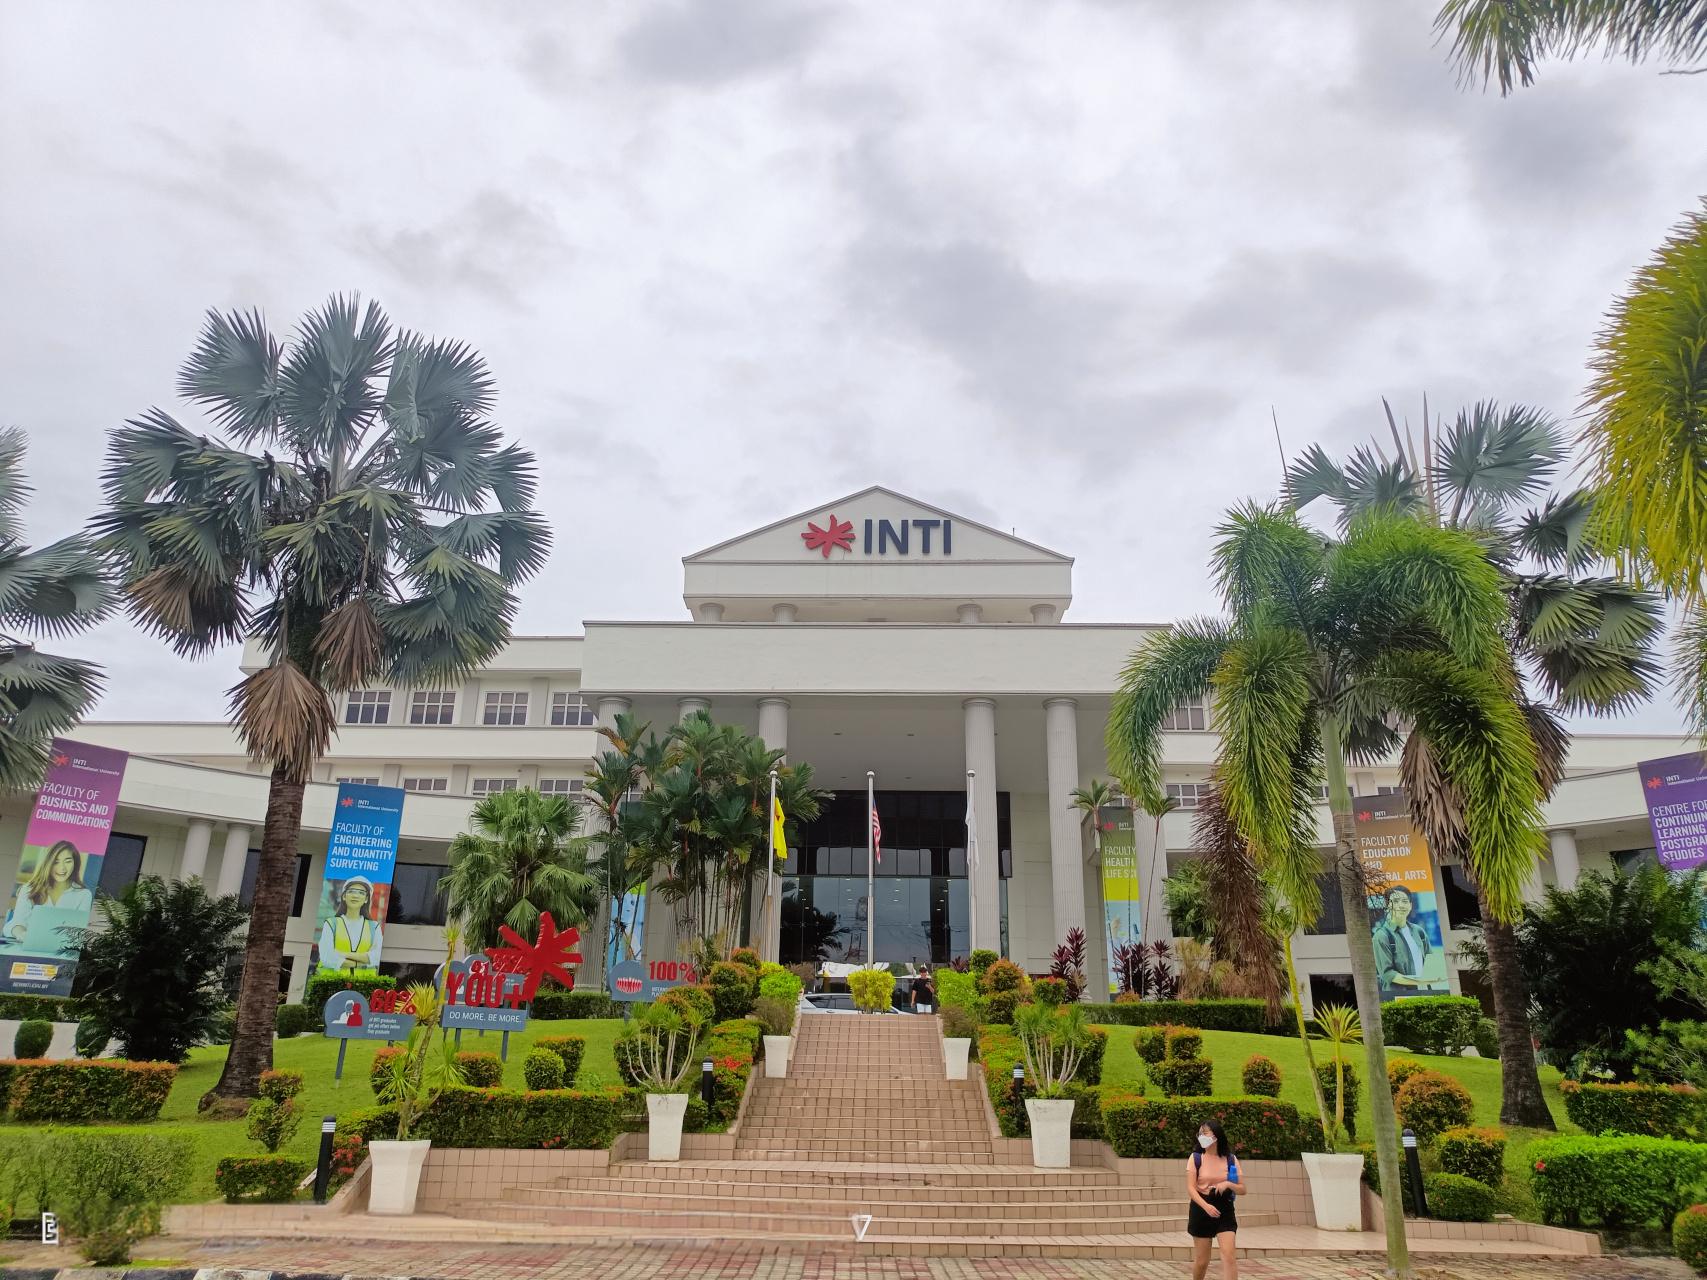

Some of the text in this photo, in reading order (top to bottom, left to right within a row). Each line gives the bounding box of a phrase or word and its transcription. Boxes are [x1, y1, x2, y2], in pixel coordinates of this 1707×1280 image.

[864, 519, 952, 555] INTI
[43, 782, 100, 800] FACULTY OF
[40, 795, 109, 816] BUSINESS AND
[1652, 802, 1691, 817] CENTRE
[36, 808, 111, 829] COMMUNICATIONS
[336, 822, 384, 836] FACULTY OF
[1657, 824, 1706, 839] LEARNING
[334, 834, 392, 848] ENGINEERING
[1361, 834, 1410, 847] FACULTY OF
[332, 846, 393, 860] AND QUANTITY
[1104, 846, 1136, 855] FACULTY
[1363, 846, 1411, 859] EDUCATION
[1662, 847, 1704, 861] STUDIES
[330, 858, 379, 871] SURVEYING
[1105, 869, 1122, 878] LIFE
[1405, 869, 1427, 881] ARTS
[649, 960, 697, 983] 100%
[449, 1011, 522, 1023] DO MORE. BE MORE.
